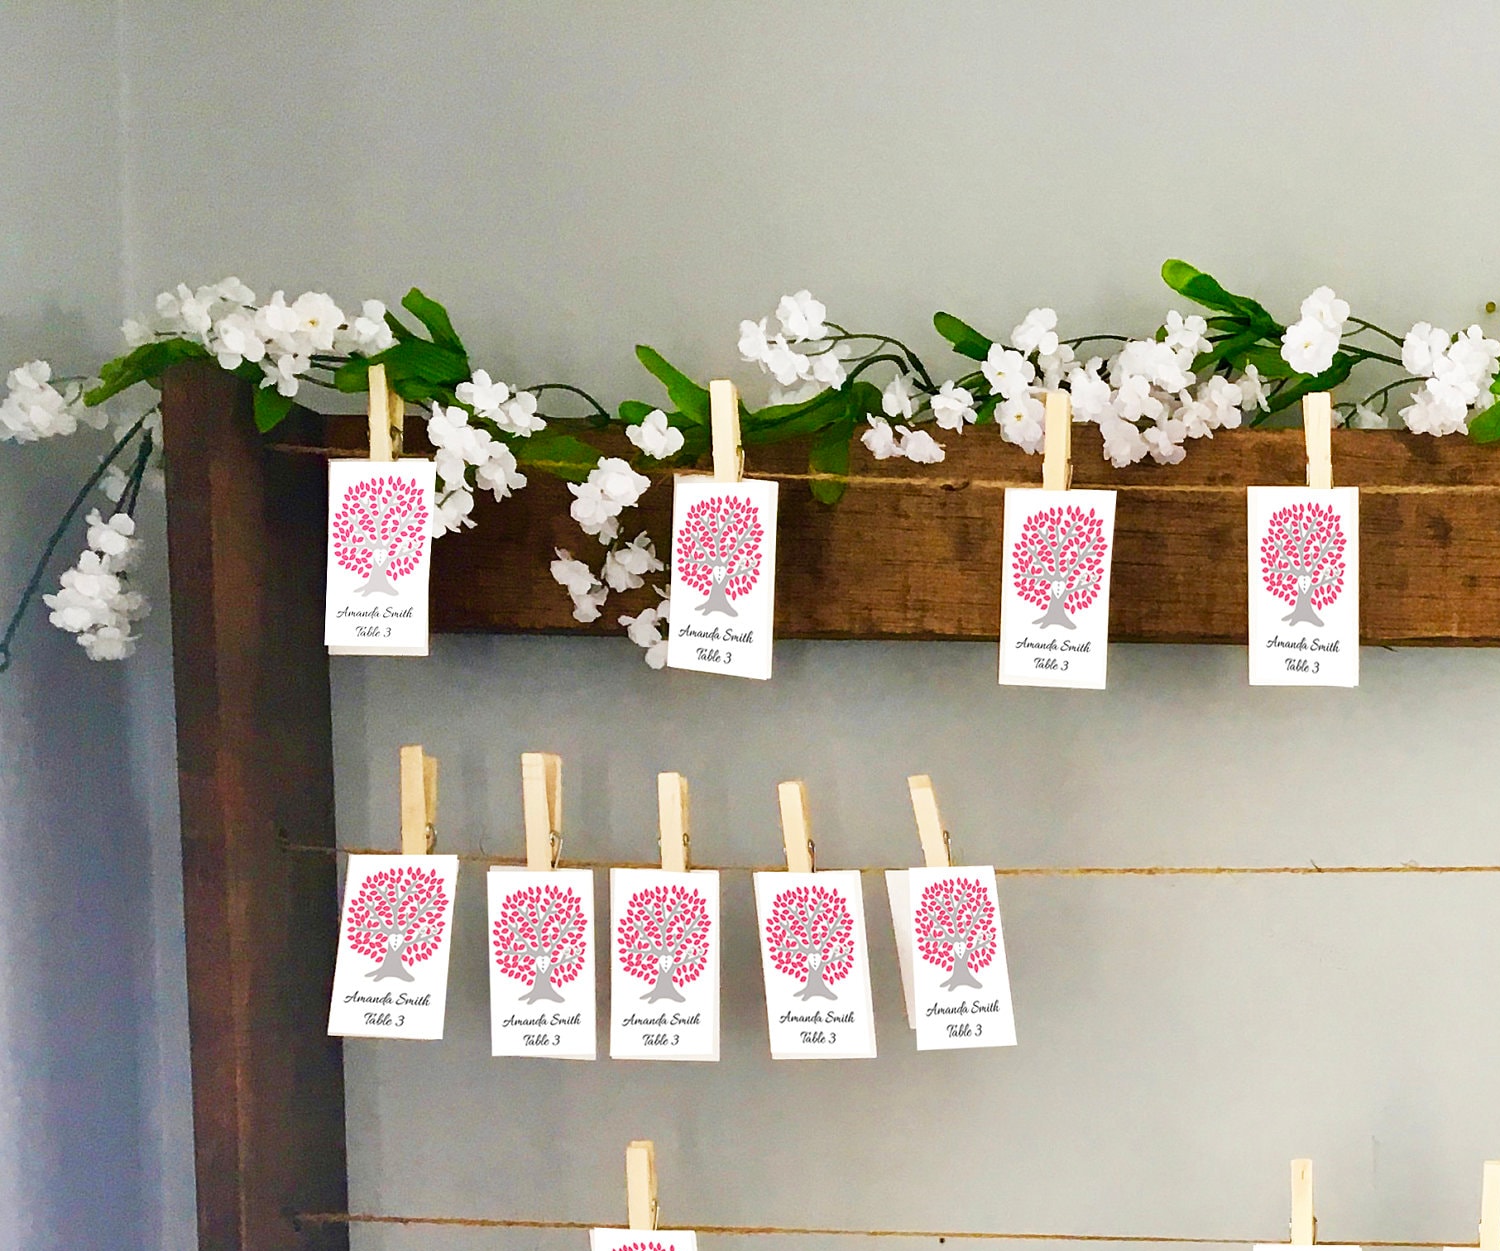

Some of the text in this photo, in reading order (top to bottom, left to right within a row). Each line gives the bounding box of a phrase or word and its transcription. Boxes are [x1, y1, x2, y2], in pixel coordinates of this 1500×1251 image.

[336, 605, 414, 619] Amanda Smith
[355, 625, 392, 638] Table 3
[678, 624, 754, 644] Amanda Smith
[1015, 636, 1092, 653] Amanda Smith
[1266, 635, 1340, 653] Amanda Smith
[696, 647, 732, 665] Table 3
[1033, 657, 1070, 671] Table 3
[1284, 657, 1320, 674] Table 3
[343, 990, 431, 1007] Amanda Smith
[925, 999, 999, 1017] Amanda Smith
[363, 1012, 406, 1027] Table 3
[502, 1012, 581, 1028] Amanda Smith
[621, 1012, 701, 1027] Amanda Smith
[778, 1010, 855, 1025] Amanda Smith
[799, 1030, 837, 1044] Table 3
[946, 1023, 983, 1038] Table 3
[522, 1033, 561, 1047] Table 3
[642, 1033, 680, 1047] Table 3
